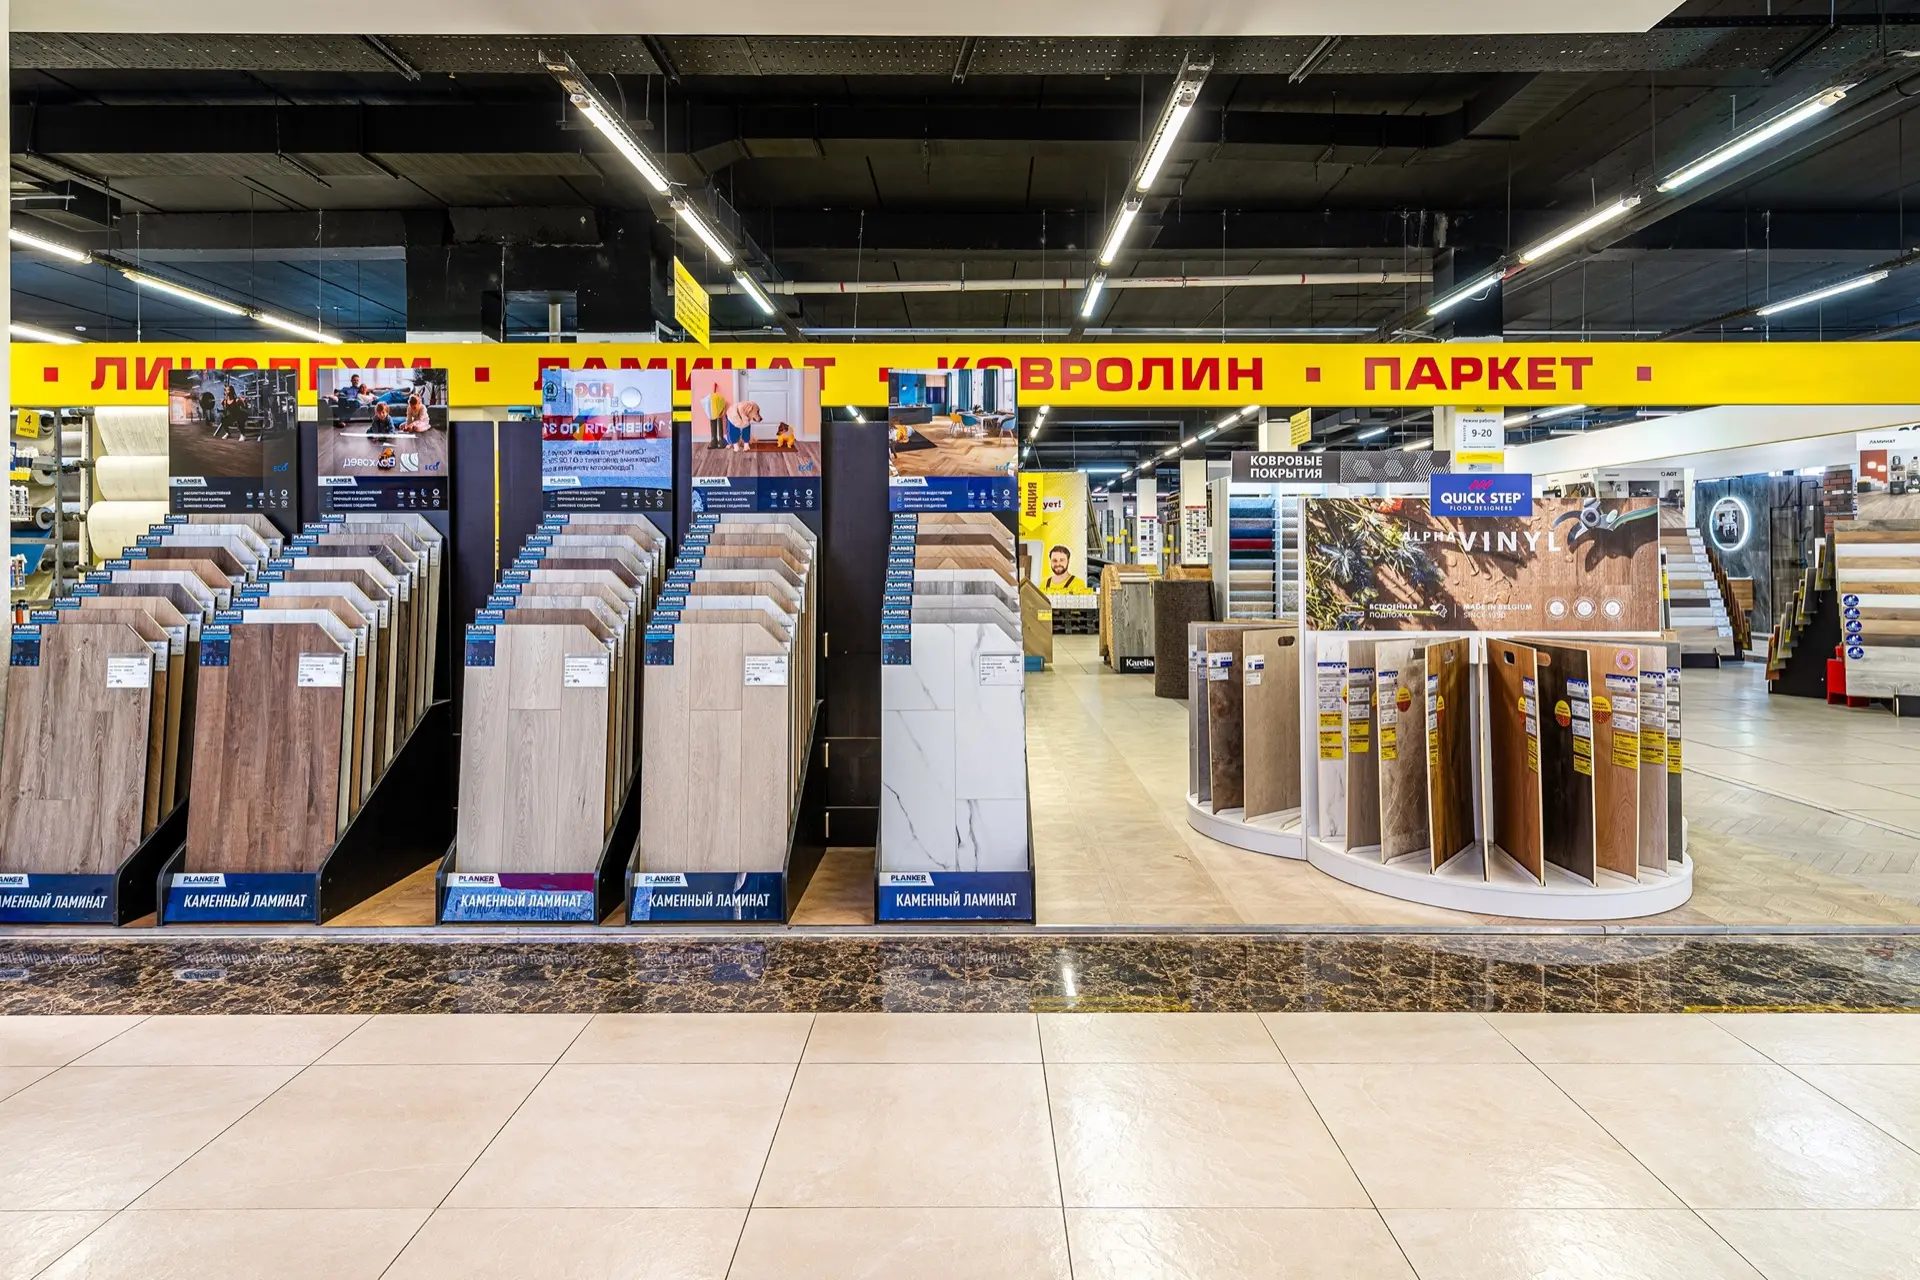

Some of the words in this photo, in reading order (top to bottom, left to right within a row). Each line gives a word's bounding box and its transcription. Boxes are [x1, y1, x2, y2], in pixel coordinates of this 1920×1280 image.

[1364, 357, 1593, 391] ПАРКЕТ
[25, 414, 32, 425] 4
[1471, 429, 1493, 438] 9-20
[1250, 456, 1323, 466] КОВРОВЫЕ
[1250, 468, 1323, 479] ПОКРЫТИЯ
[1026, 482, 1038, 518] Акция
[1440, 492, 1486, 505] QUICK
[1490, 492, 1522, 504] STEP
[1401, 531, 1456, 542] ALPHA
[1458, 531, 1562, 552] VINYL
[1369, 611, 1414, 619] ПОДЛОЖКА
[1126, 658, 1154, 667] Karelia
[458, 875, 495, 884] PLANKER
[645, 875, 681, 884] PLANKER
[890, 874, 927, 882] PLANKER
[52, 895, 108, 908] ЛАМИНАТ
[184, 892, 250, 908] КАМЕННЫЙ
[250, 894, 307, 908] ЛАМИНАТ
[460, 891, 528, 908] КАМЕННЫЙ
[528, 894, 583, 908] ЛАМИНАТ
[648, 891, 714, 908] КАМЕННЫЙ
[715, 894, 770, 908] ЛАМИНАТ
[896, 890, 960, 907] КАМЕННЫЙ
[962, 893, 1017, 907] ЛАМИНАТ
